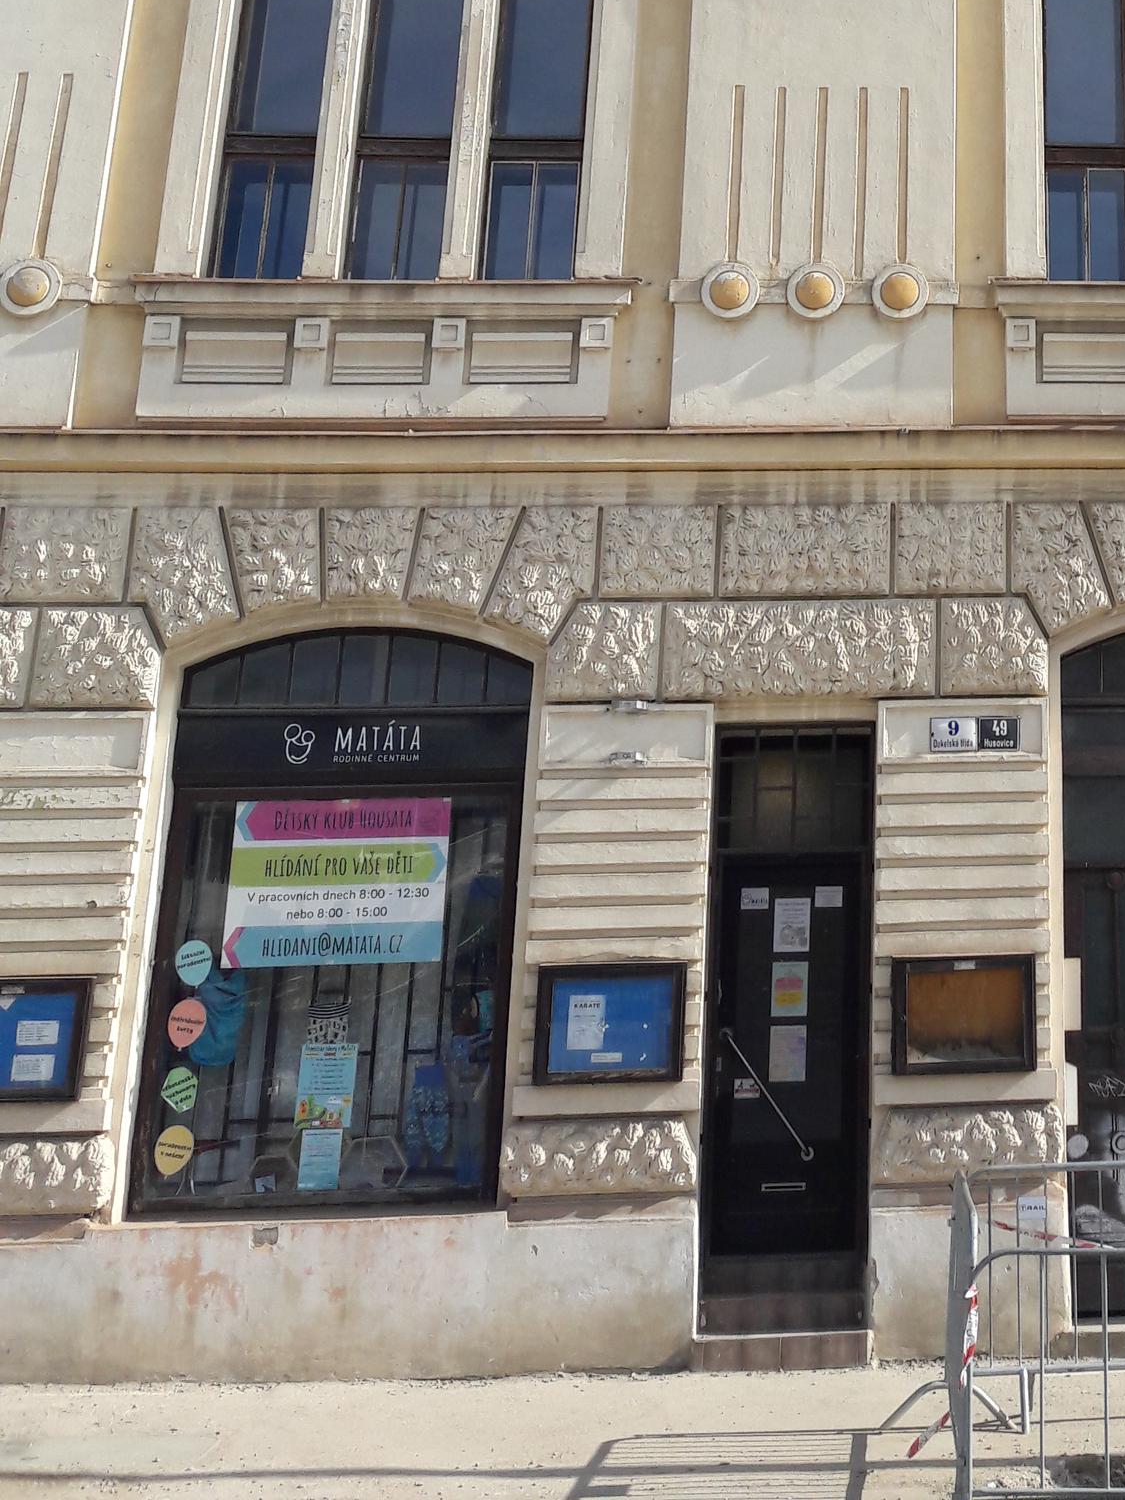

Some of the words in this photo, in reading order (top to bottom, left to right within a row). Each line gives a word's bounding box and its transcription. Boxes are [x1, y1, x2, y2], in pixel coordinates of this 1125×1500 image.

[334, 718, 421, 754] MATÁTA
[947, 719, 960, 737] 9
[992, 719, 1008, 737] 49
[983, 738, 1014, 749] Husovice
[333, 753, 372, 764] RODINNÉ
[376, 753, 421, 764] CENTRUM
[323, 810, 355, 831] KLUB
[264, 852, 323, 878] HLÍDÁNÍ
[324, 857, 348, 877] PRO
[352, 850, 382, 876] VAŠE
[386, 850, 414, 875] DĚTI
[247, 892, 256, 902] V
[258, 890, 320, 905] pracovních
[322, 887, 356, 902] dnech
[359, 888, 386, 900] 8:00
[397, 887, 431, 899] 12:30
[286, 907, 315, 920] nebo
[317, 907, 344, 919] 8:00
[355, 905, 389, 918] 15:00
[262, 932, 404, 958] HLIDANI@MATATA.CZ
